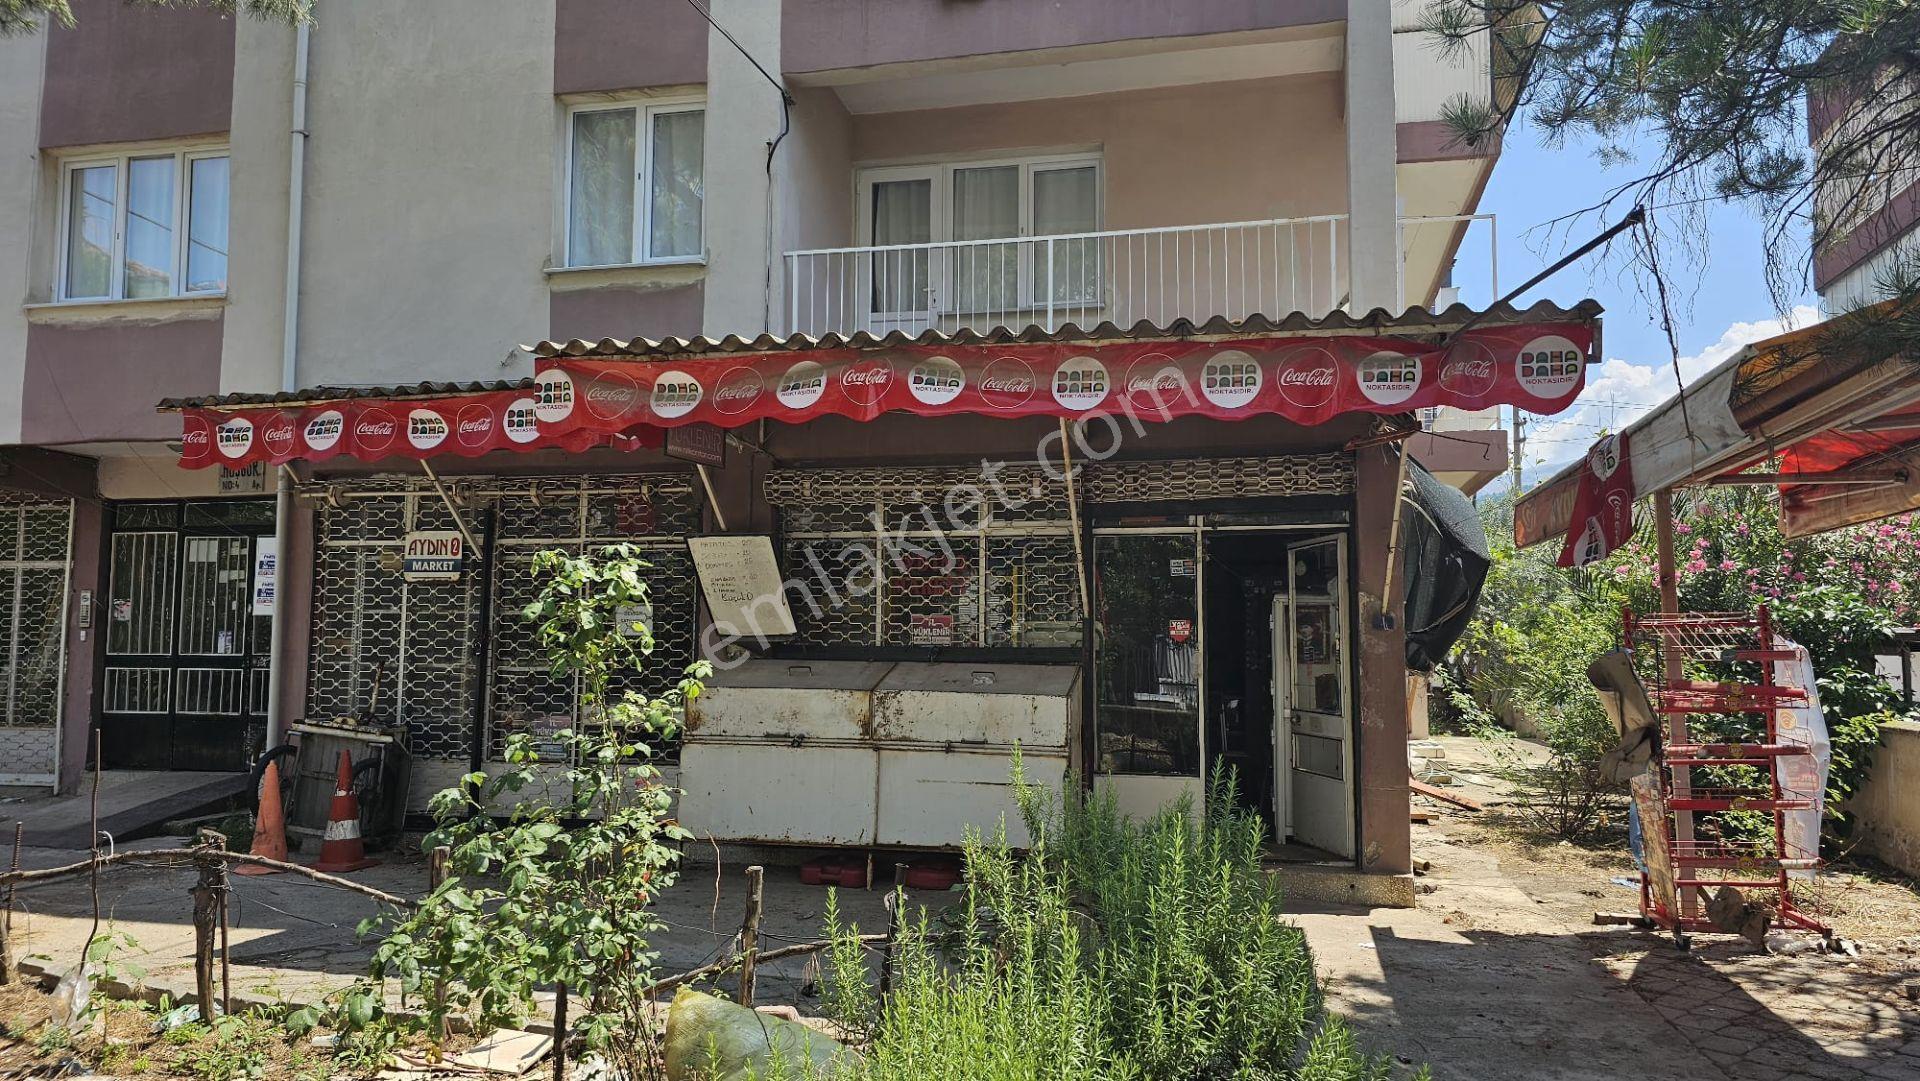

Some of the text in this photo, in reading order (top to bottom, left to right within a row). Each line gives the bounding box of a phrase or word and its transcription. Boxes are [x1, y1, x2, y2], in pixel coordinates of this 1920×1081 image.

[1522, 350, 1578, 364] DAHA
[1057, 370, 1105, 381] DAHA
[1206, 364, 1257, 376] DAHA
[1363, 370, 1415, 382] DAHA
[1521, 363, 1578, 377] DAHA
[843, 367, 890, 386] Coca-Cola
[913, 376, 959, 388] DAHA
[1206, 376, 1256, 388] DAHA
[1281, 367, 1336, 386] Coca-Cola
[535, 381, 571, 393] DAHA
[657, 383, 698, 393] DAHA
[781, 379, 821, 392] DAHA
[981, 376, 1031, 393] Coca-Cola
[1057, 382, 1104, 393] DAHA
[535, 393, 571, 404] DAHA
[508, 409, 537, 419] DAH
[310, 418, 342, 428] DAHA
[410, 417, 443, 426] DAHA
[460, 418, 492, 433] Coca-Cola
[508, 418, 537, 428] DAH
[307, 425, 339, 435] DAHA
[357, 421, 394, 435] Coca-Cola
[411, 425, 445, 434] DAHA
[408, 539, 448, 556] AYDIN
[412, 560, 455, 571] MARKET
